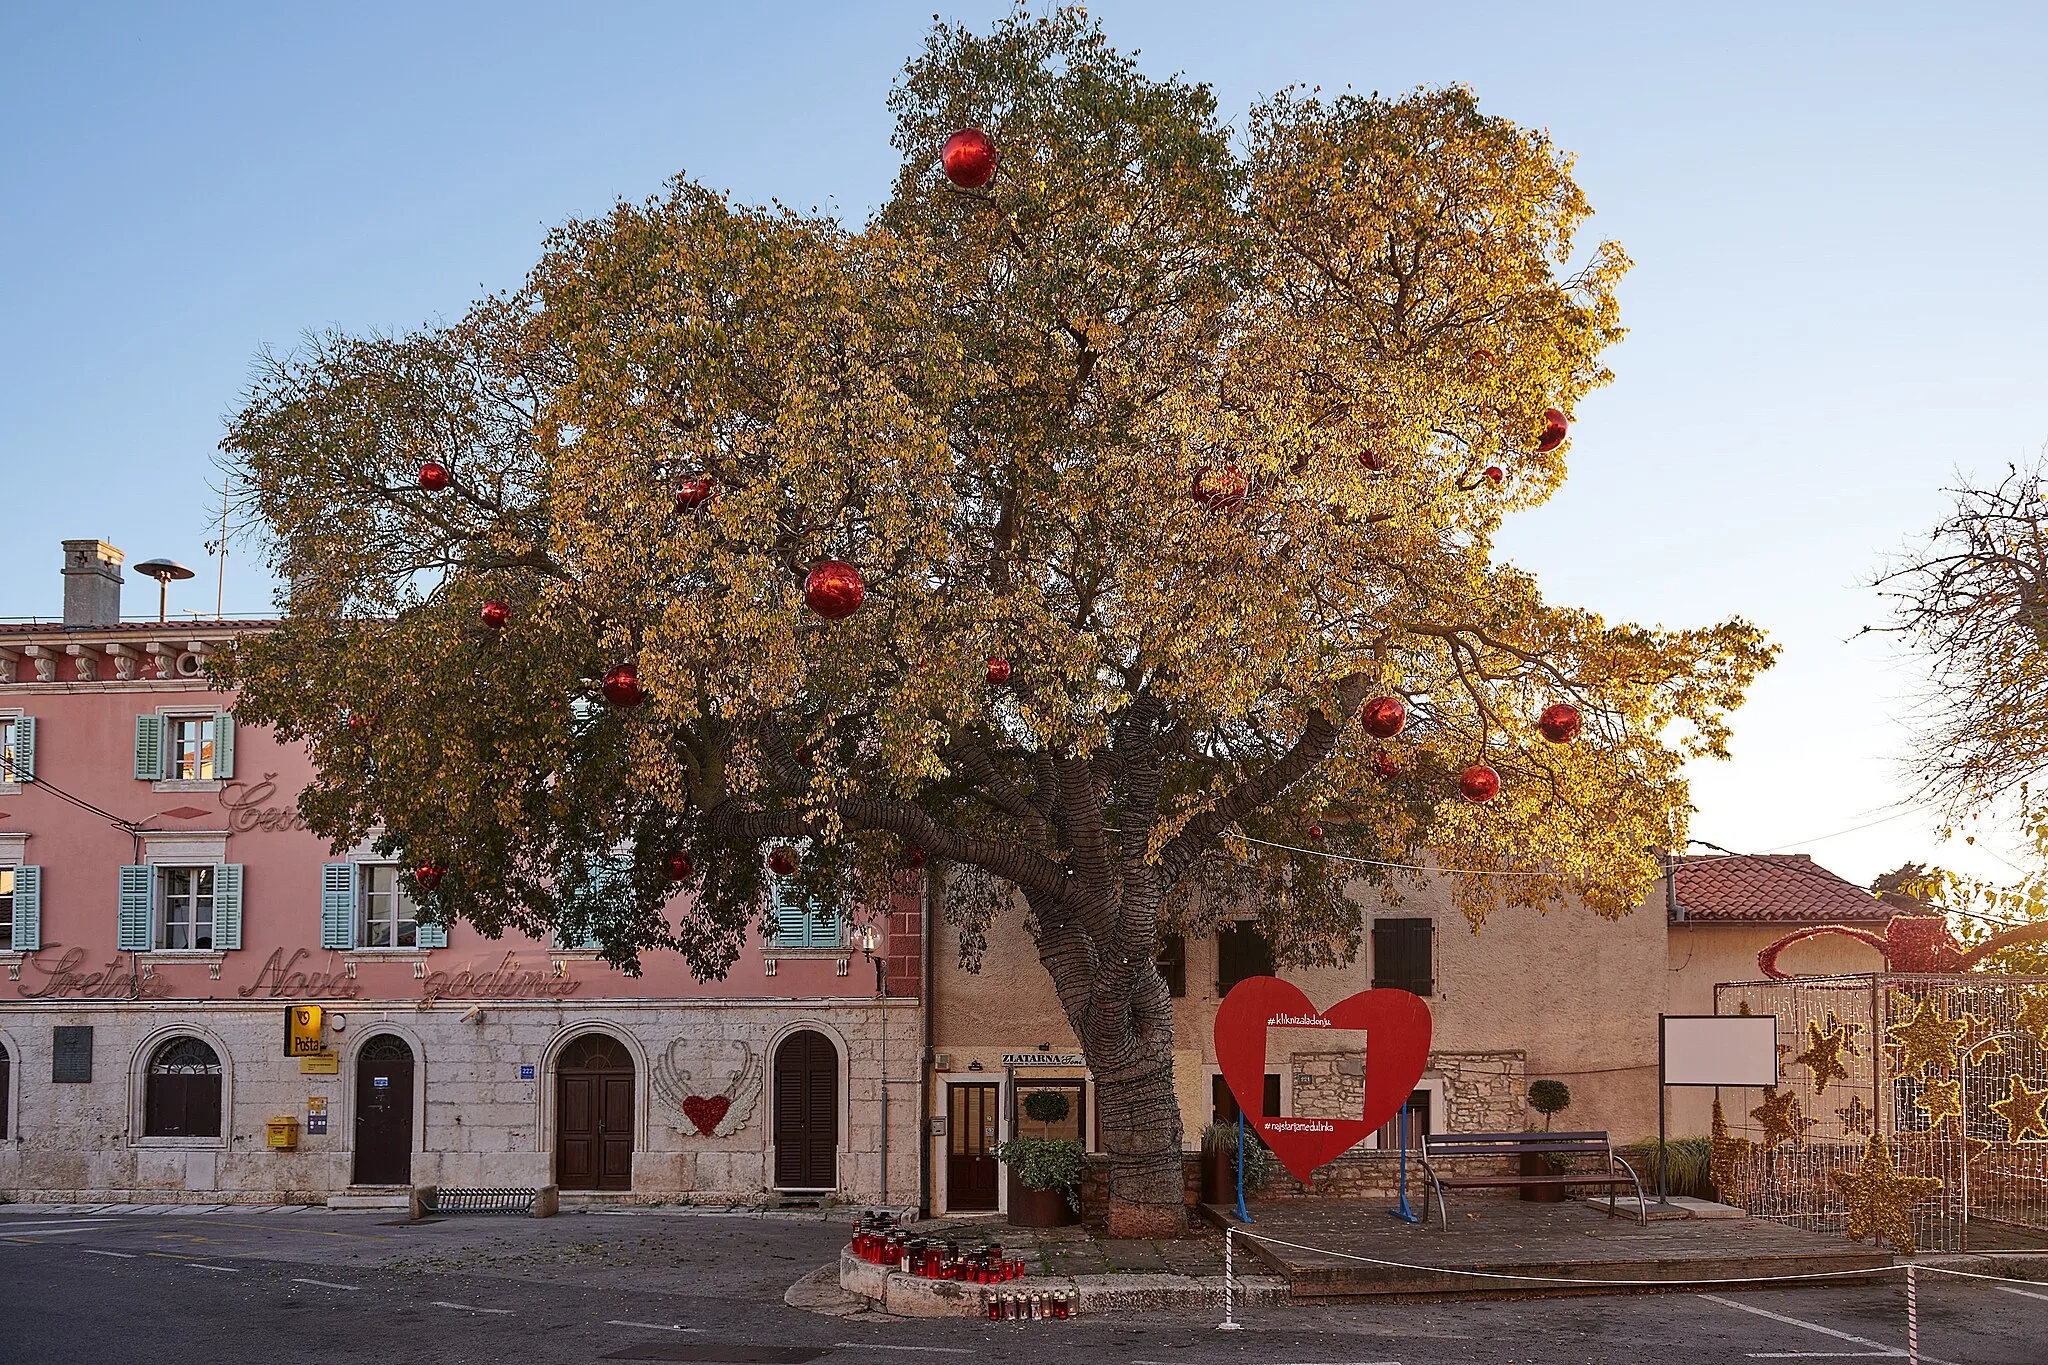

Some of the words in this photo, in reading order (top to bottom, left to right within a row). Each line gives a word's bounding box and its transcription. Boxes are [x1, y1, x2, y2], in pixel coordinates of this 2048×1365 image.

[238, 947, 362, 999] Nova
[416, 950, 580, 1012] godina
[295, 1036, 319, 1052] Pošta
[1002, 1054, 1060, 1062] ZLATARNA
